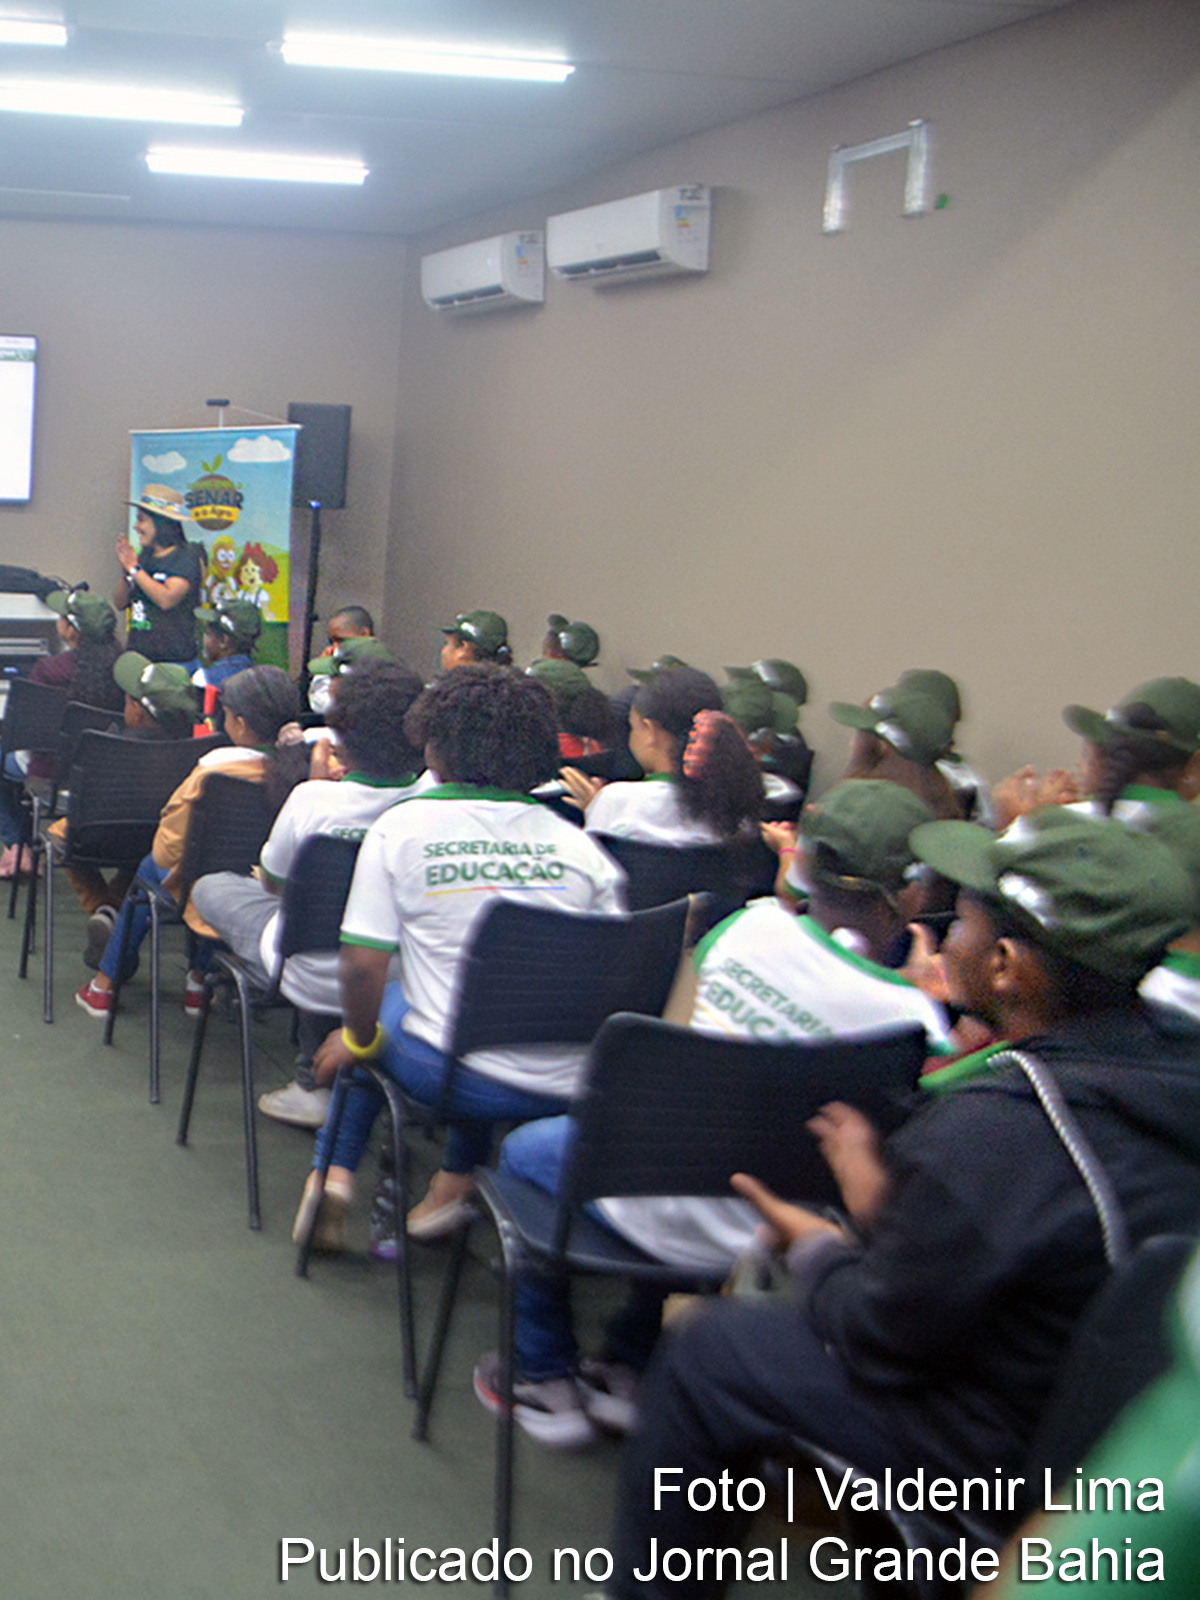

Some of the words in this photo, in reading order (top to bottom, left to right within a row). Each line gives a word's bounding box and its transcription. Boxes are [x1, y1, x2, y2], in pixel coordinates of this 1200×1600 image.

[184, 489, 245, 510] SENAR
[423, 839, 532, 858] SECRETARIA
[535, 843, 557, 854] DE
[425, 856, 565, 886] EDUCAÇÃO
